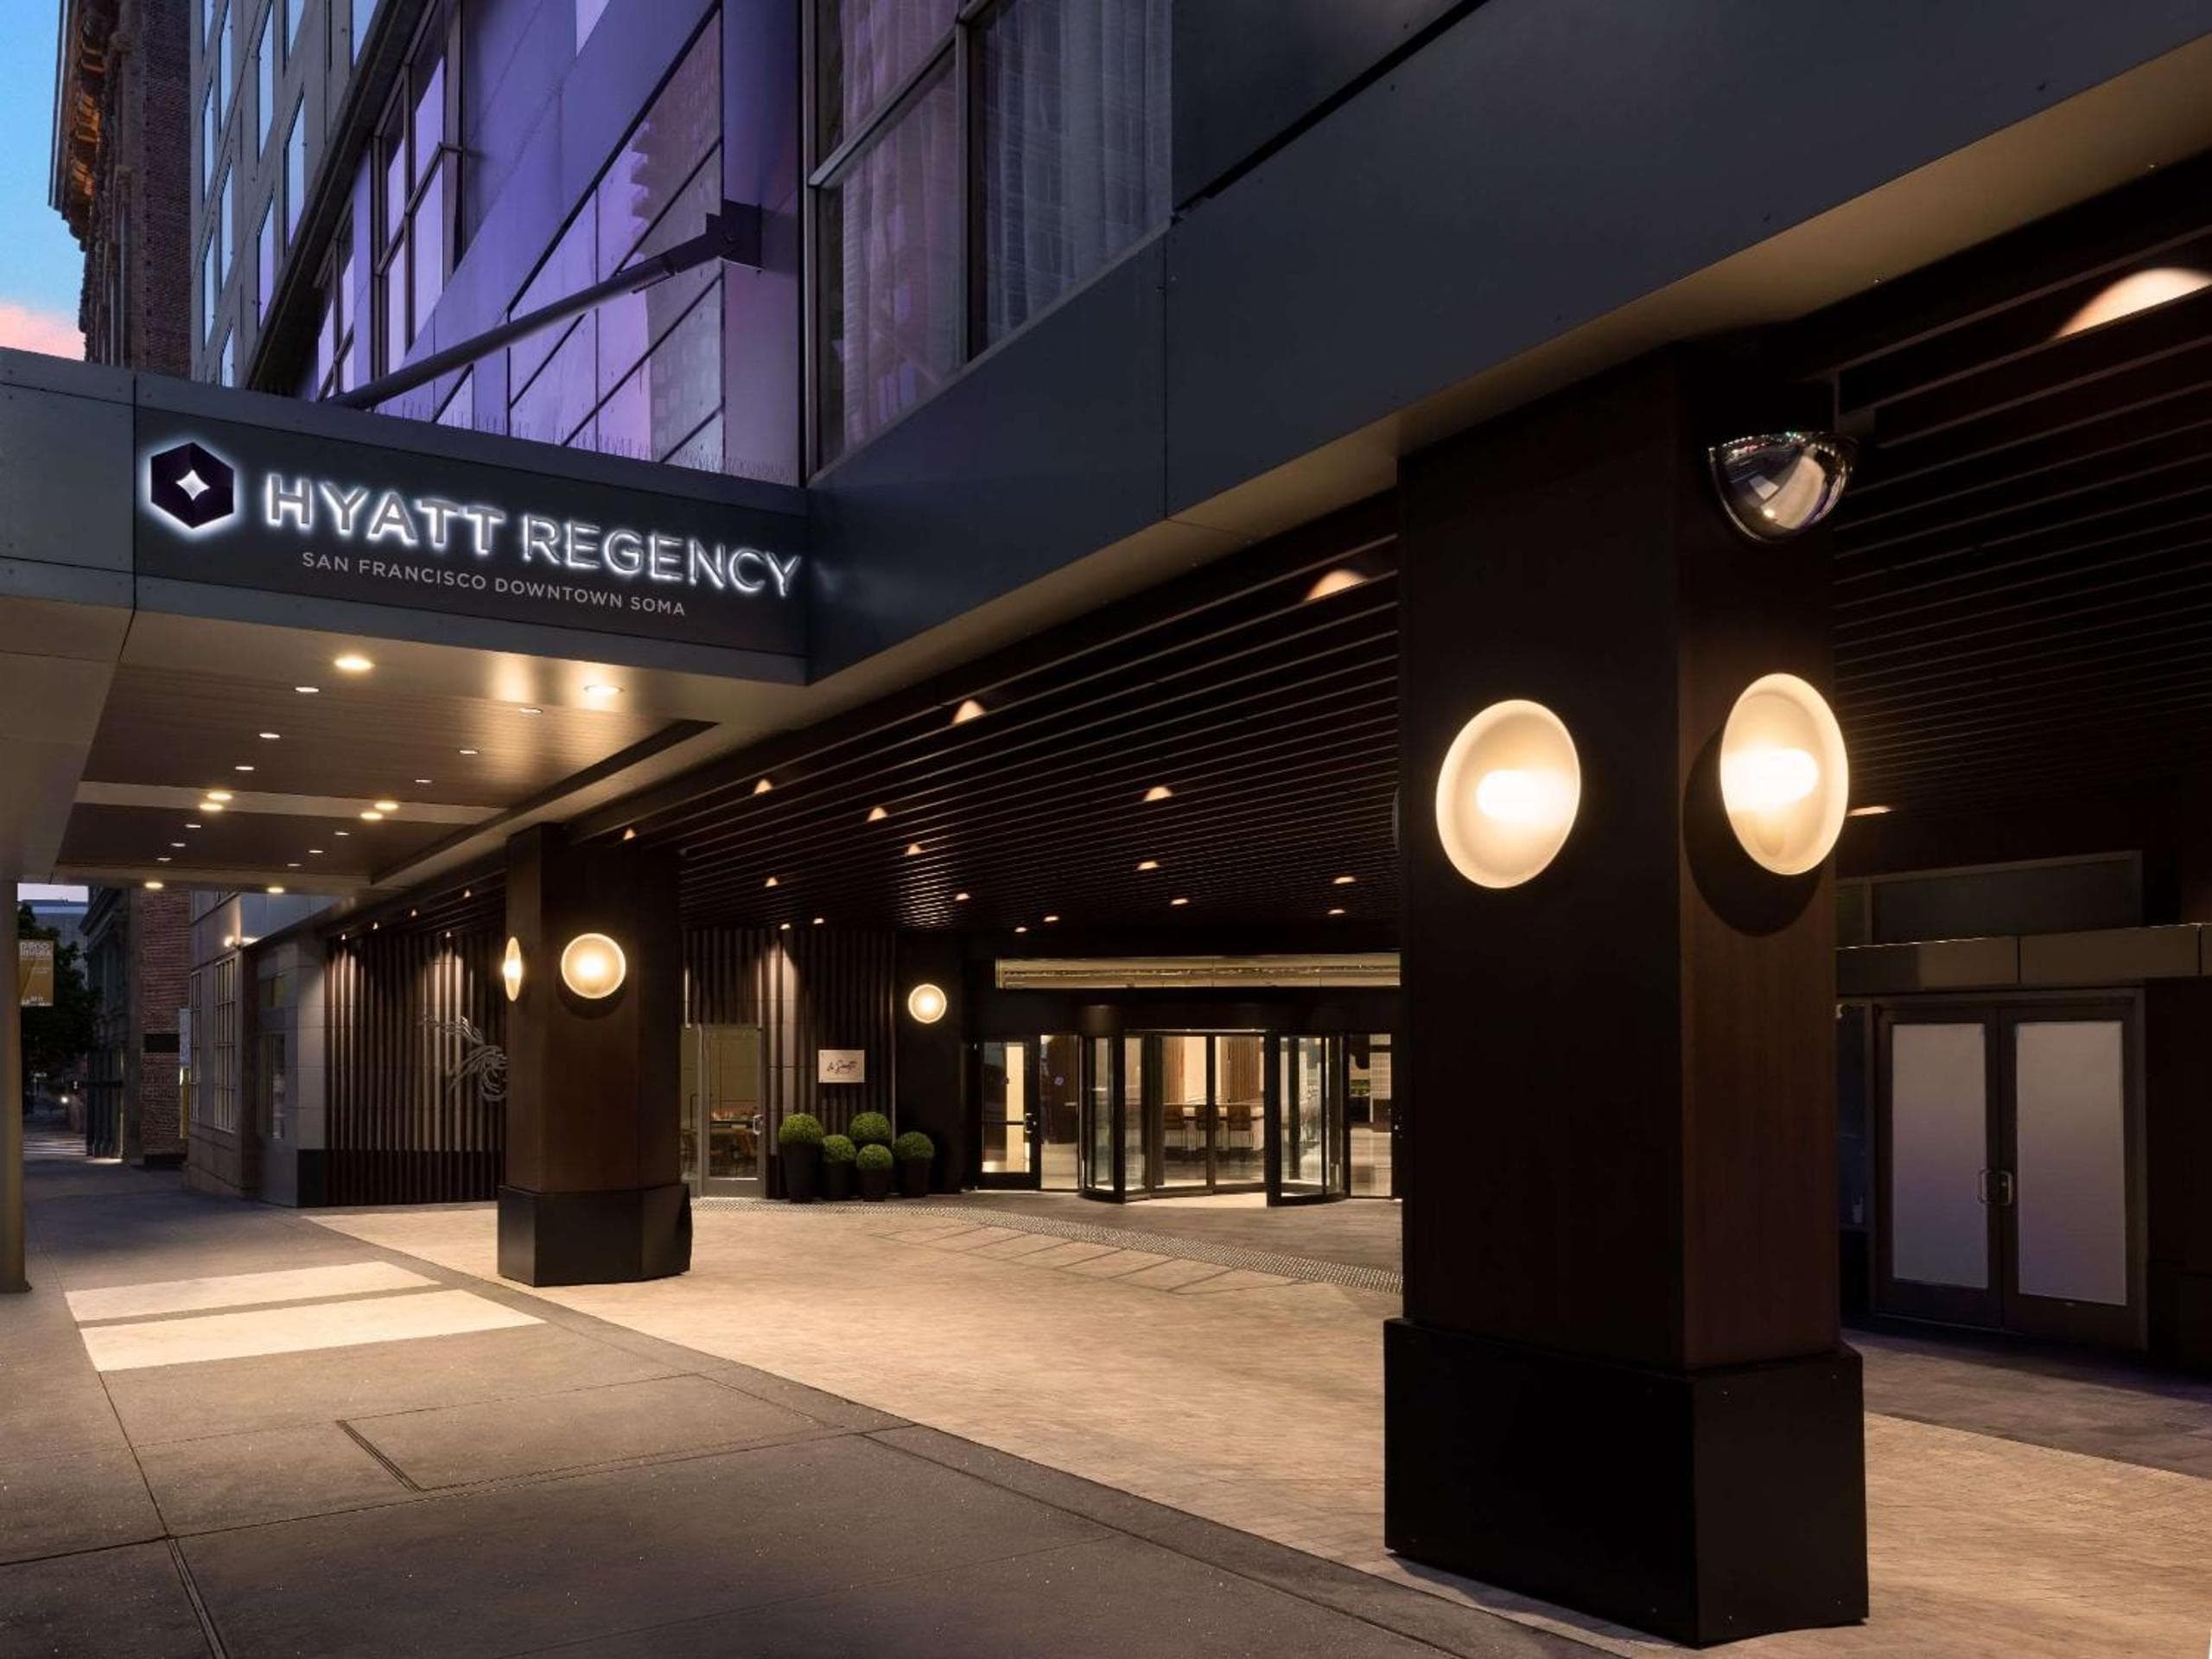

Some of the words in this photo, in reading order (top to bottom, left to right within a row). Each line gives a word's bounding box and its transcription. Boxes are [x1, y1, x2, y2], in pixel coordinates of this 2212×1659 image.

[266, 474, 506, 554] HYATT
[522, 513, 801, 597] REGENCY
[302, 552, 349, 572] SAN
[359, 560, 486, 589] FRANCISCO
[494, 577, 622, 608] DOWNTOWN
[630, 596, 685, 616] SOMA
